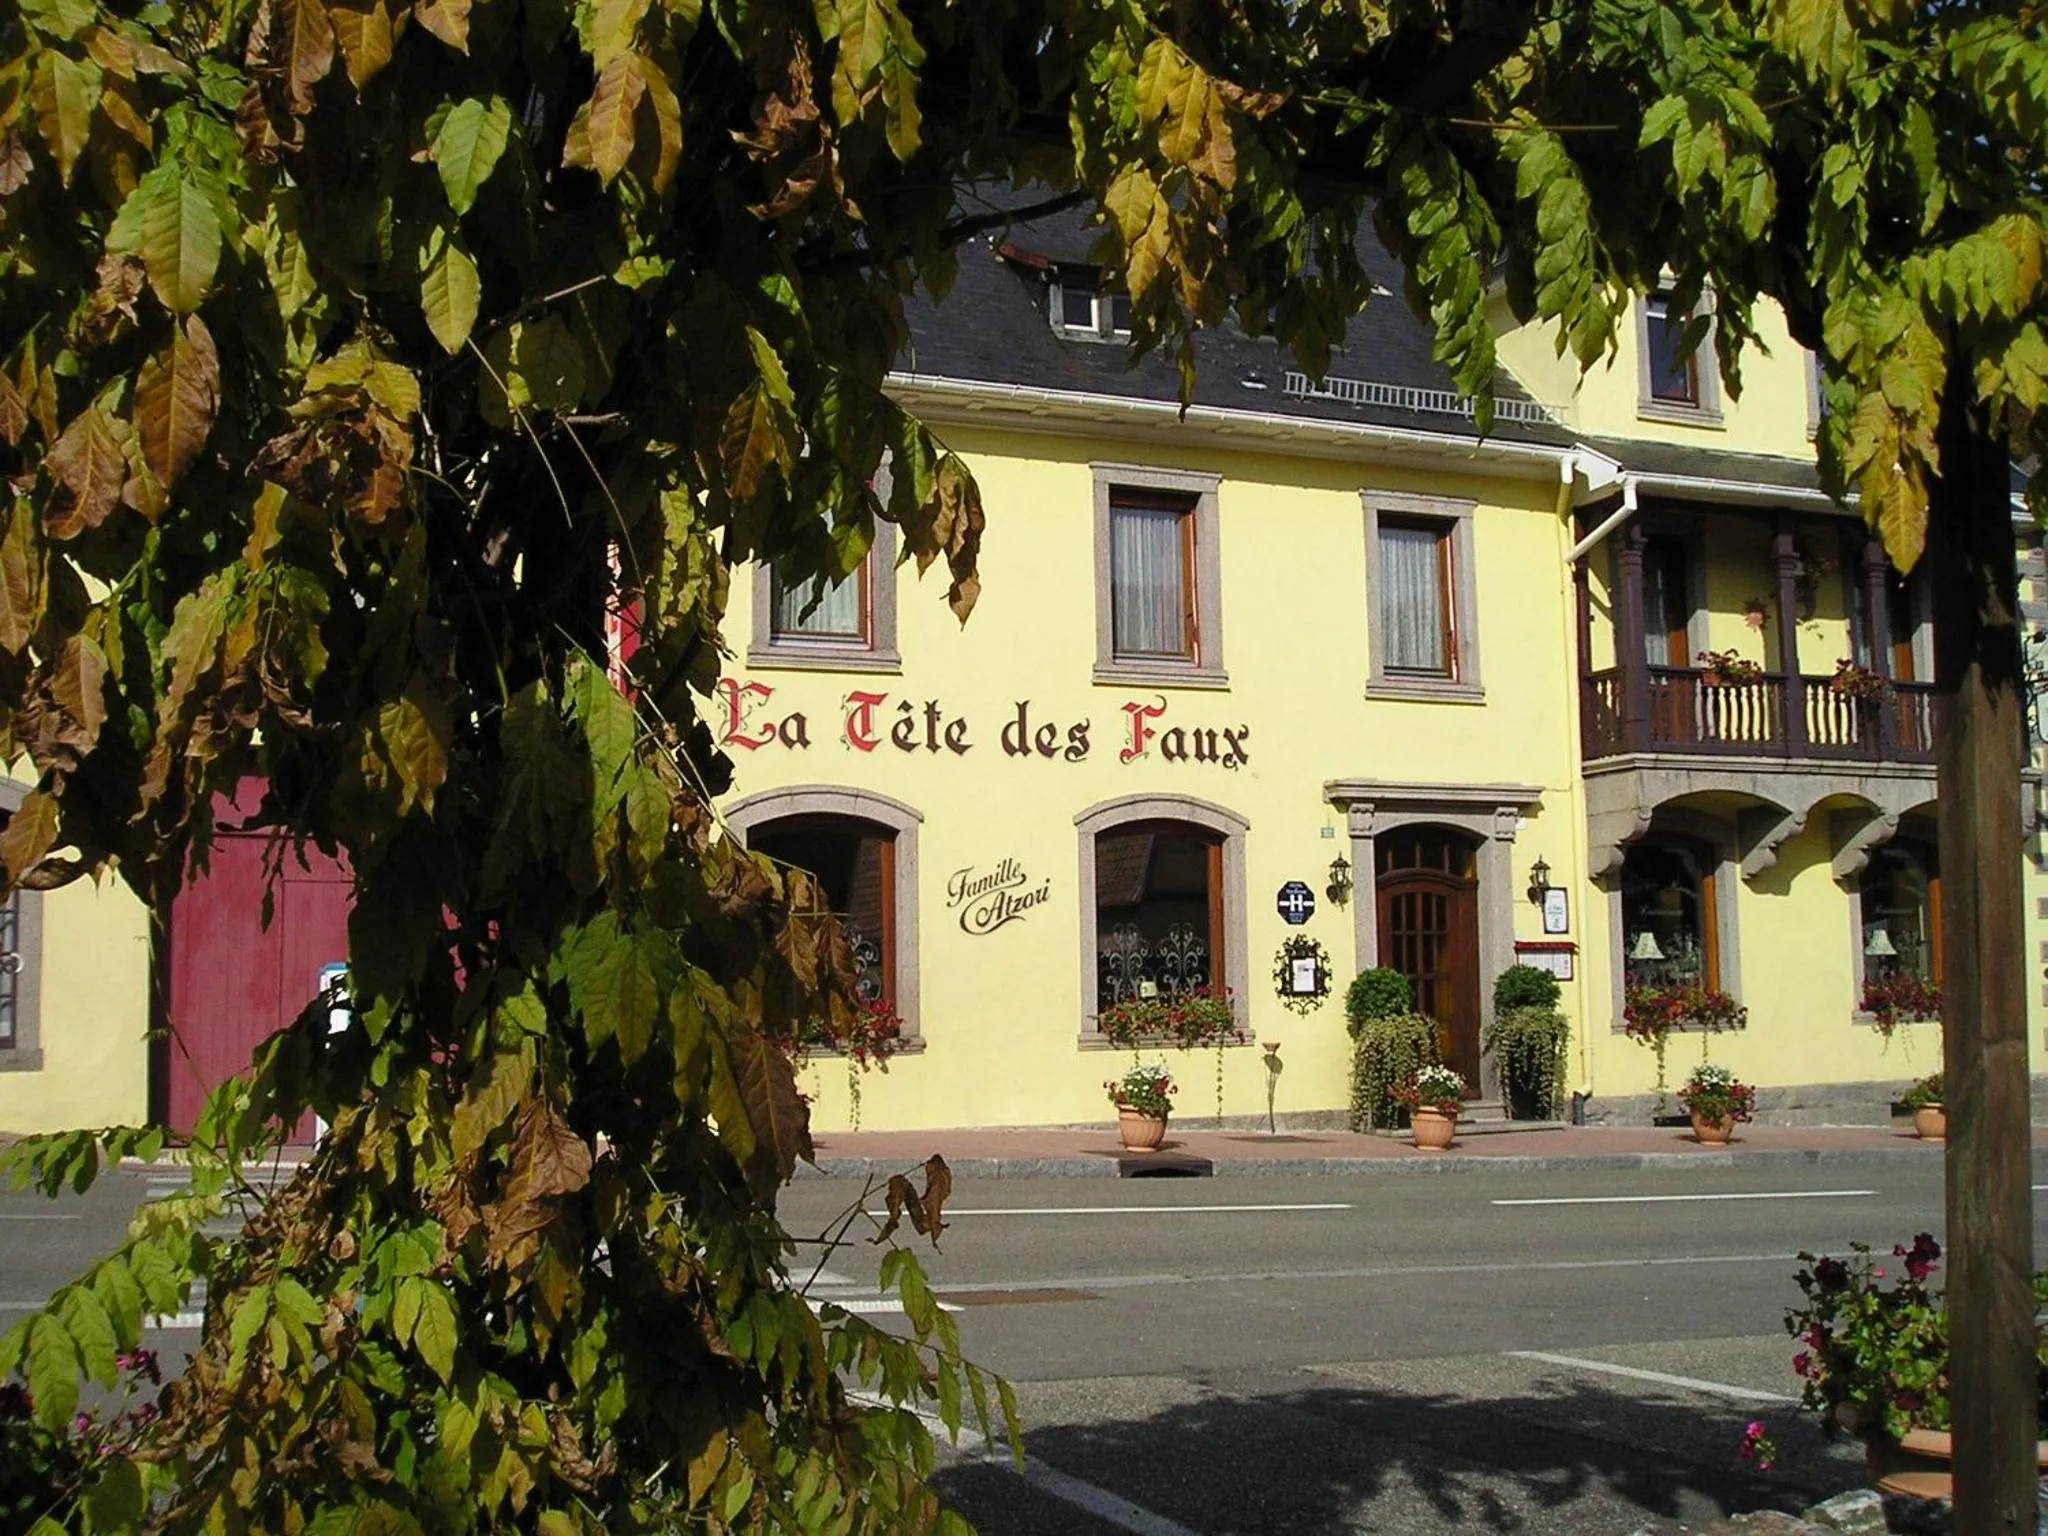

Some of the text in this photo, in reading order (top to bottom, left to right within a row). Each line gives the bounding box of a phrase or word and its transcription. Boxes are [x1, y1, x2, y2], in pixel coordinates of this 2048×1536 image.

[717, 678, 1250, 771] La Tête des Faux
[946, 858, 1024, 908] Famille
[1290, 894, 1303, 912] H
